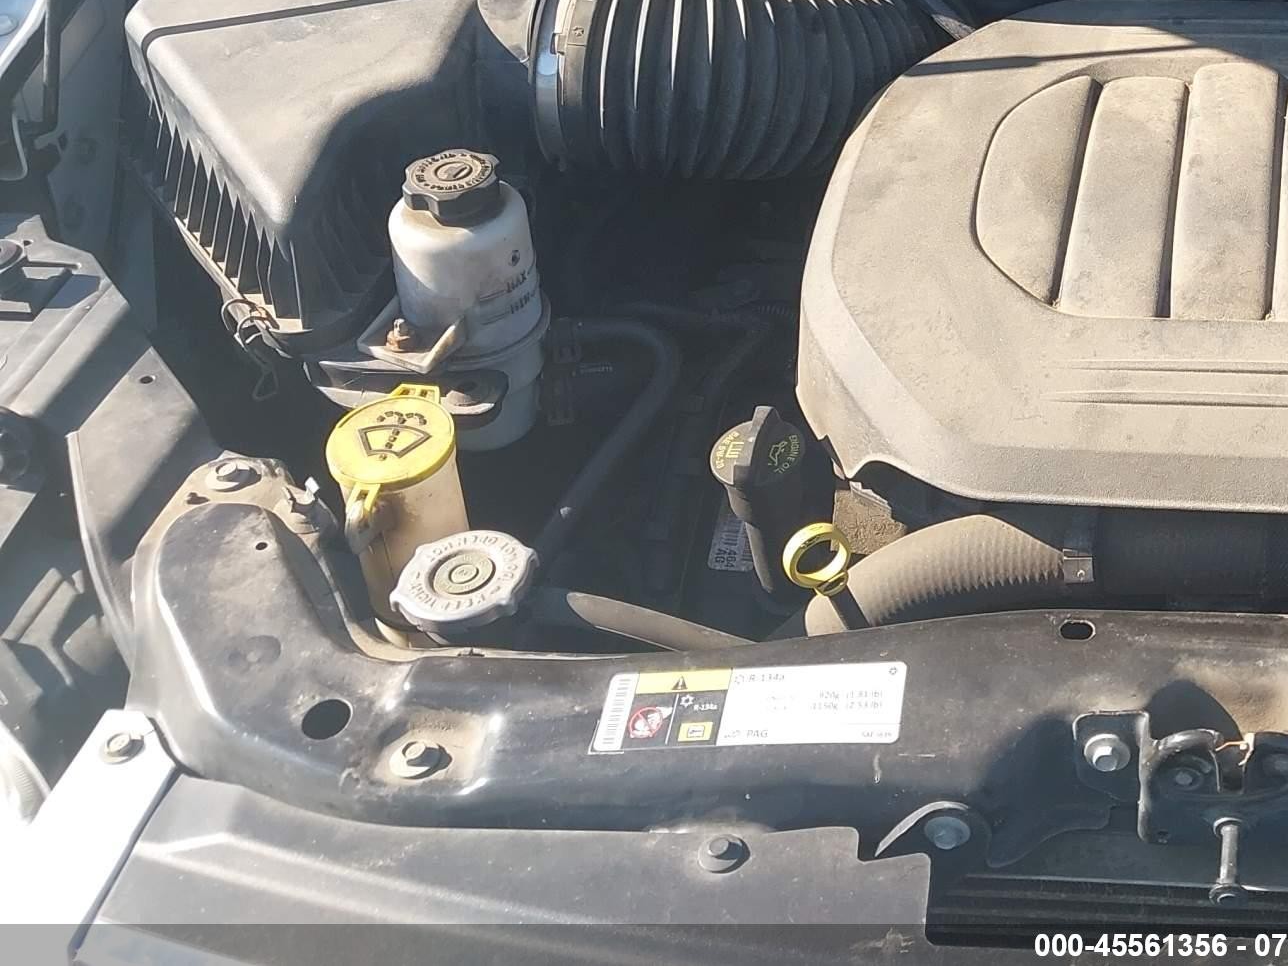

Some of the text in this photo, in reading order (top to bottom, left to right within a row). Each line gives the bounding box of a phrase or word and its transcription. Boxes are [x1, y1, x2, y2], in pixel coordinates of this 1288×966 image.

[774, 434, 801, 474] ENGINE OIL
[746, 729, 769, 738] PAG
